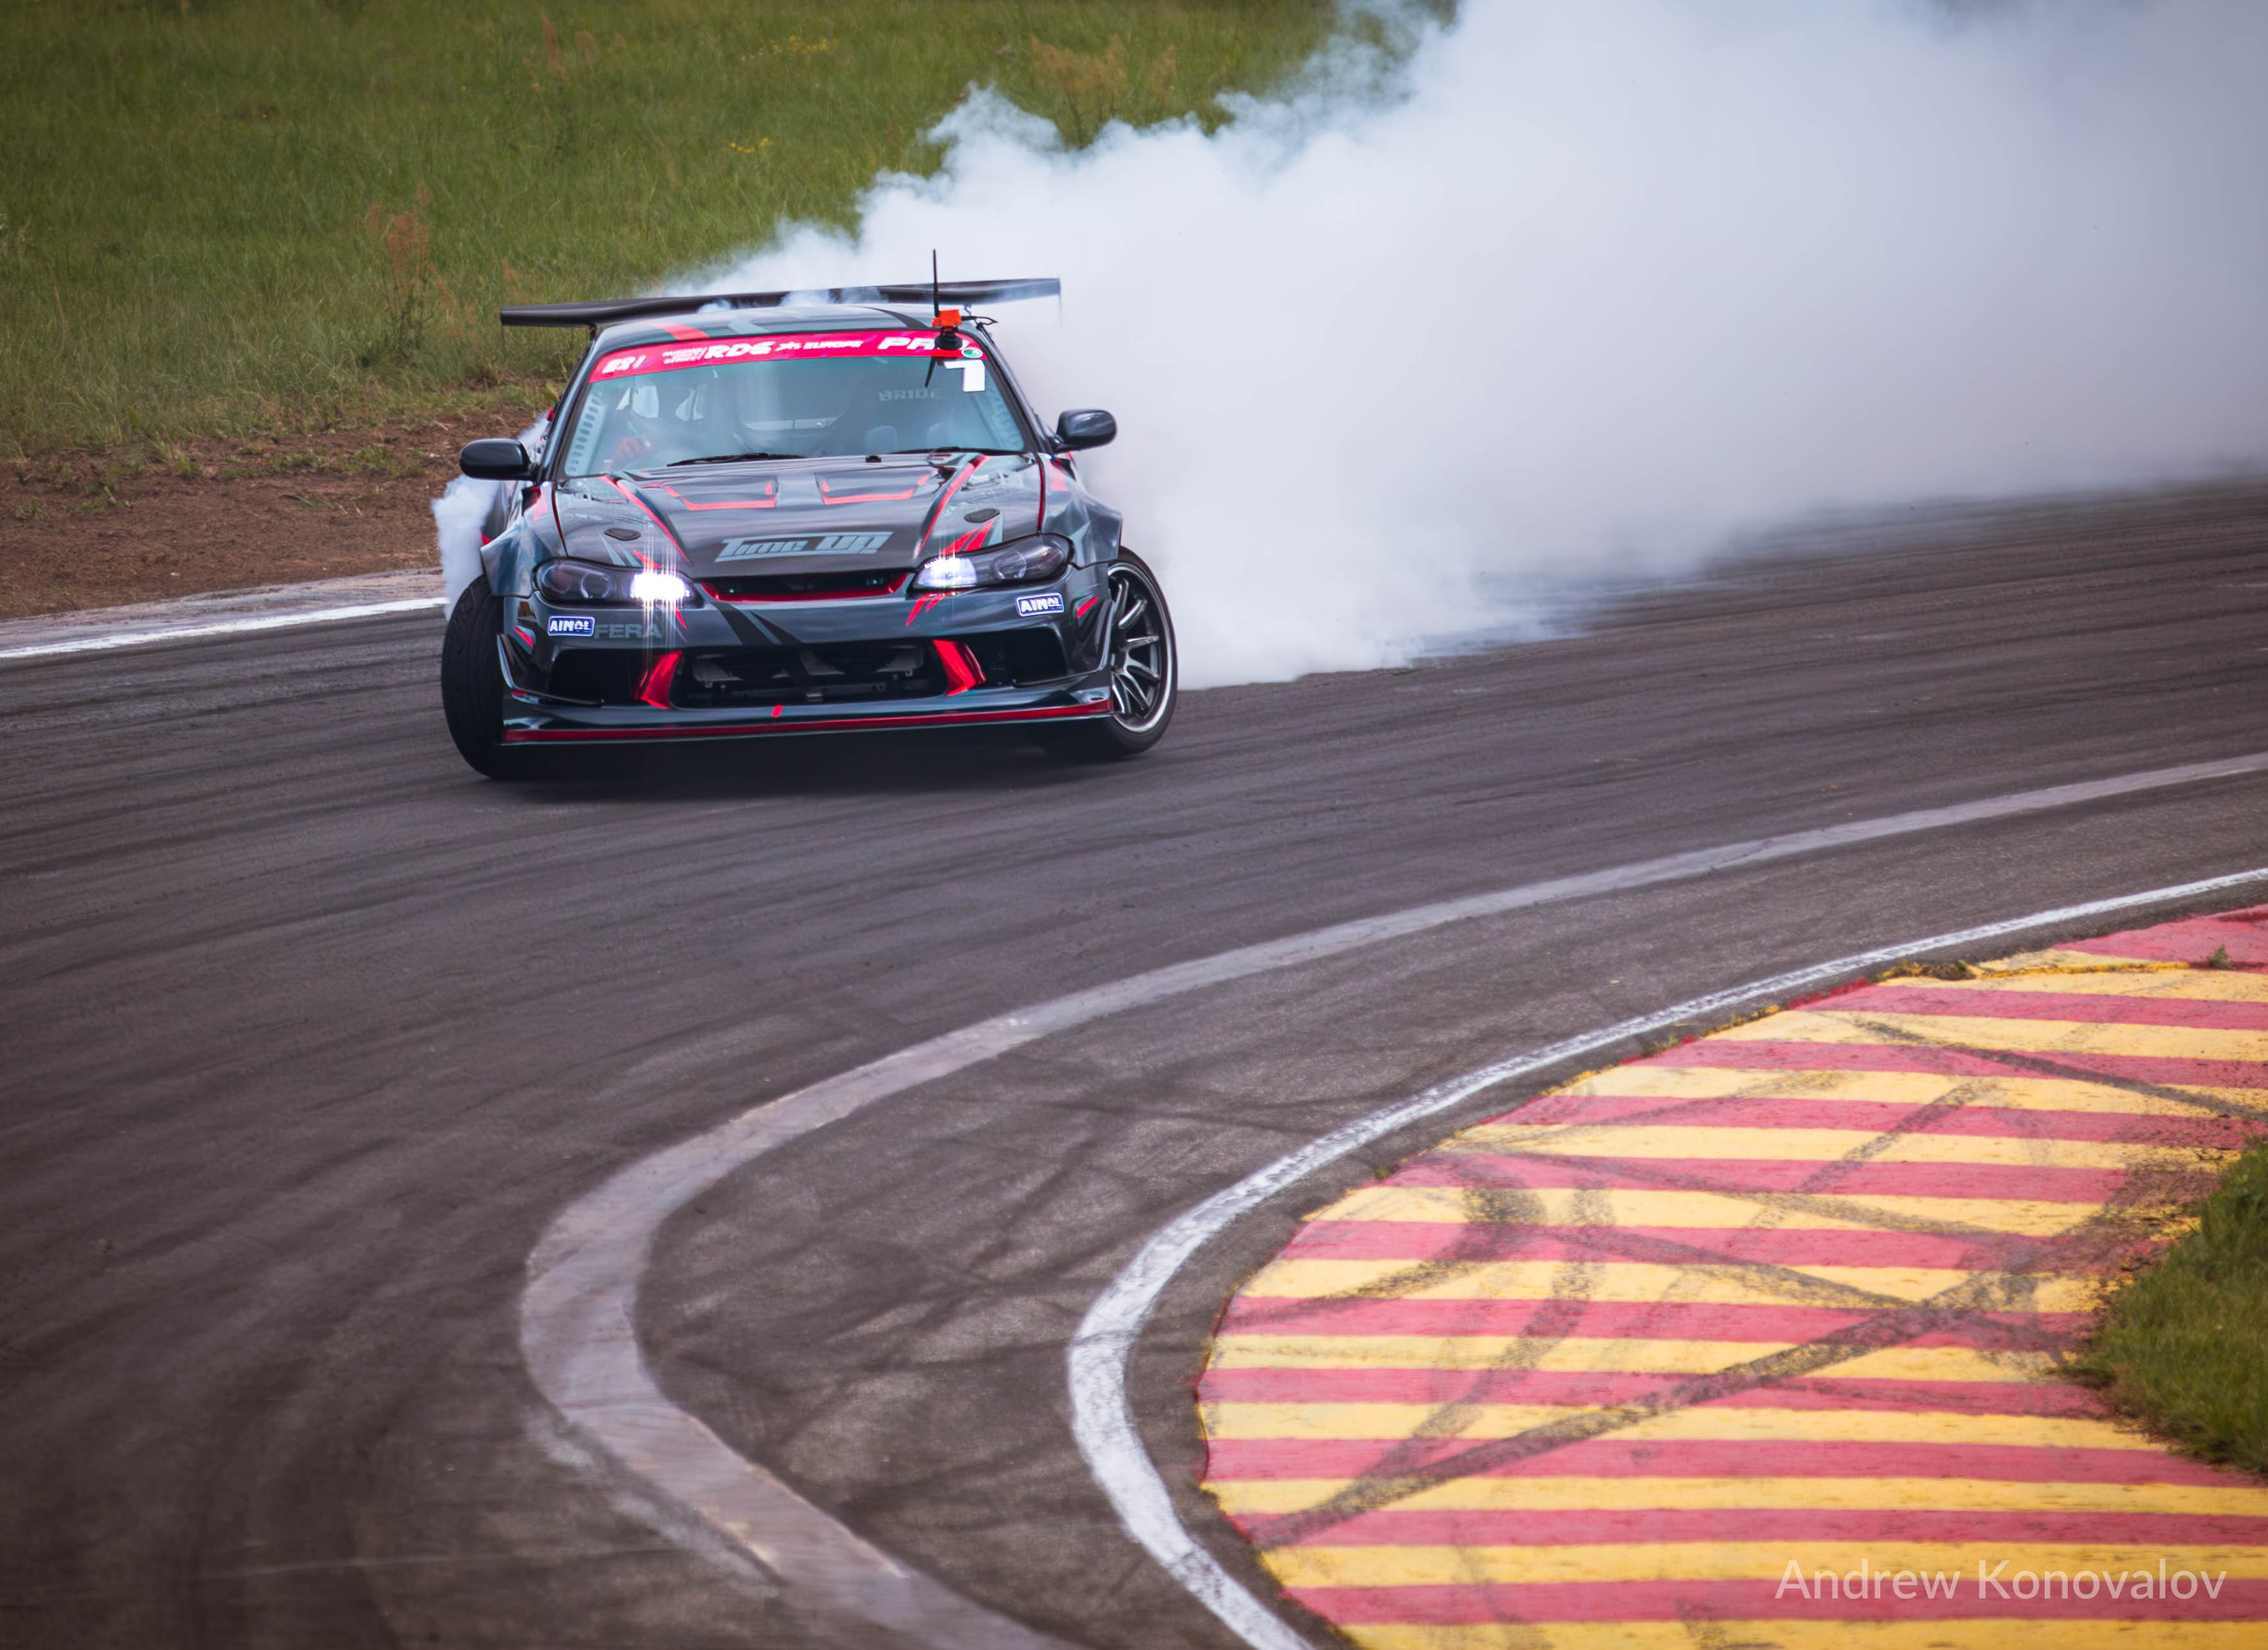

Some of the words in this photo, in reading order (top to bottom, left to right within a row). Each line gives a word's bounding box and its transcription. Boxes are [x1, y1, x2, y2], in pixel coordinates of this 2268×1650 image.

[803, 340, 864, 349] EUROPE
[877, 336, 970, 350] PR
[549, 619, 592, 632] AIMOL
